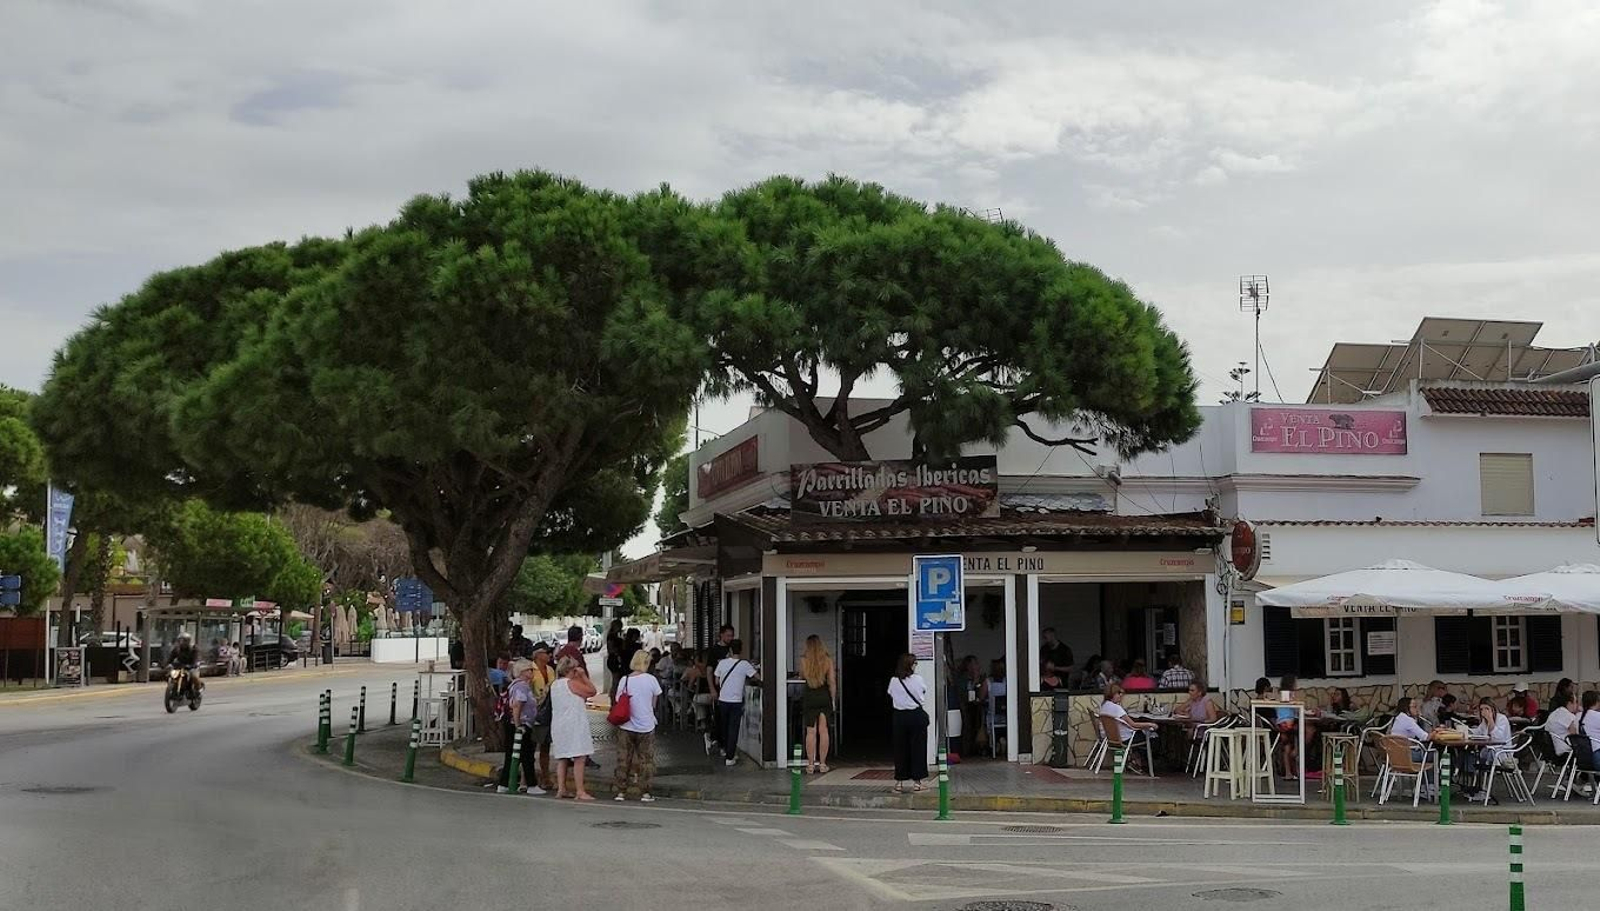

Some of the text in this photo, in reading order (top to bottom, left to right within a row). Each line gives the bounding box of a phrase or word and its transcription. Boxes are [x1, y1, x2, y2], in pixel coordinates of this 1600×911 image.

[1280, 426, 1379, 449] EL PINO
[796, 462, 991, 499] Parrilladas Ibericas
[818, 496, 969, 518] VENTA EL PINO
[997, 557, 1011, 570] EL
[1017, 557, 1044, 570] PINO
[928, 566, 951, 595] P
